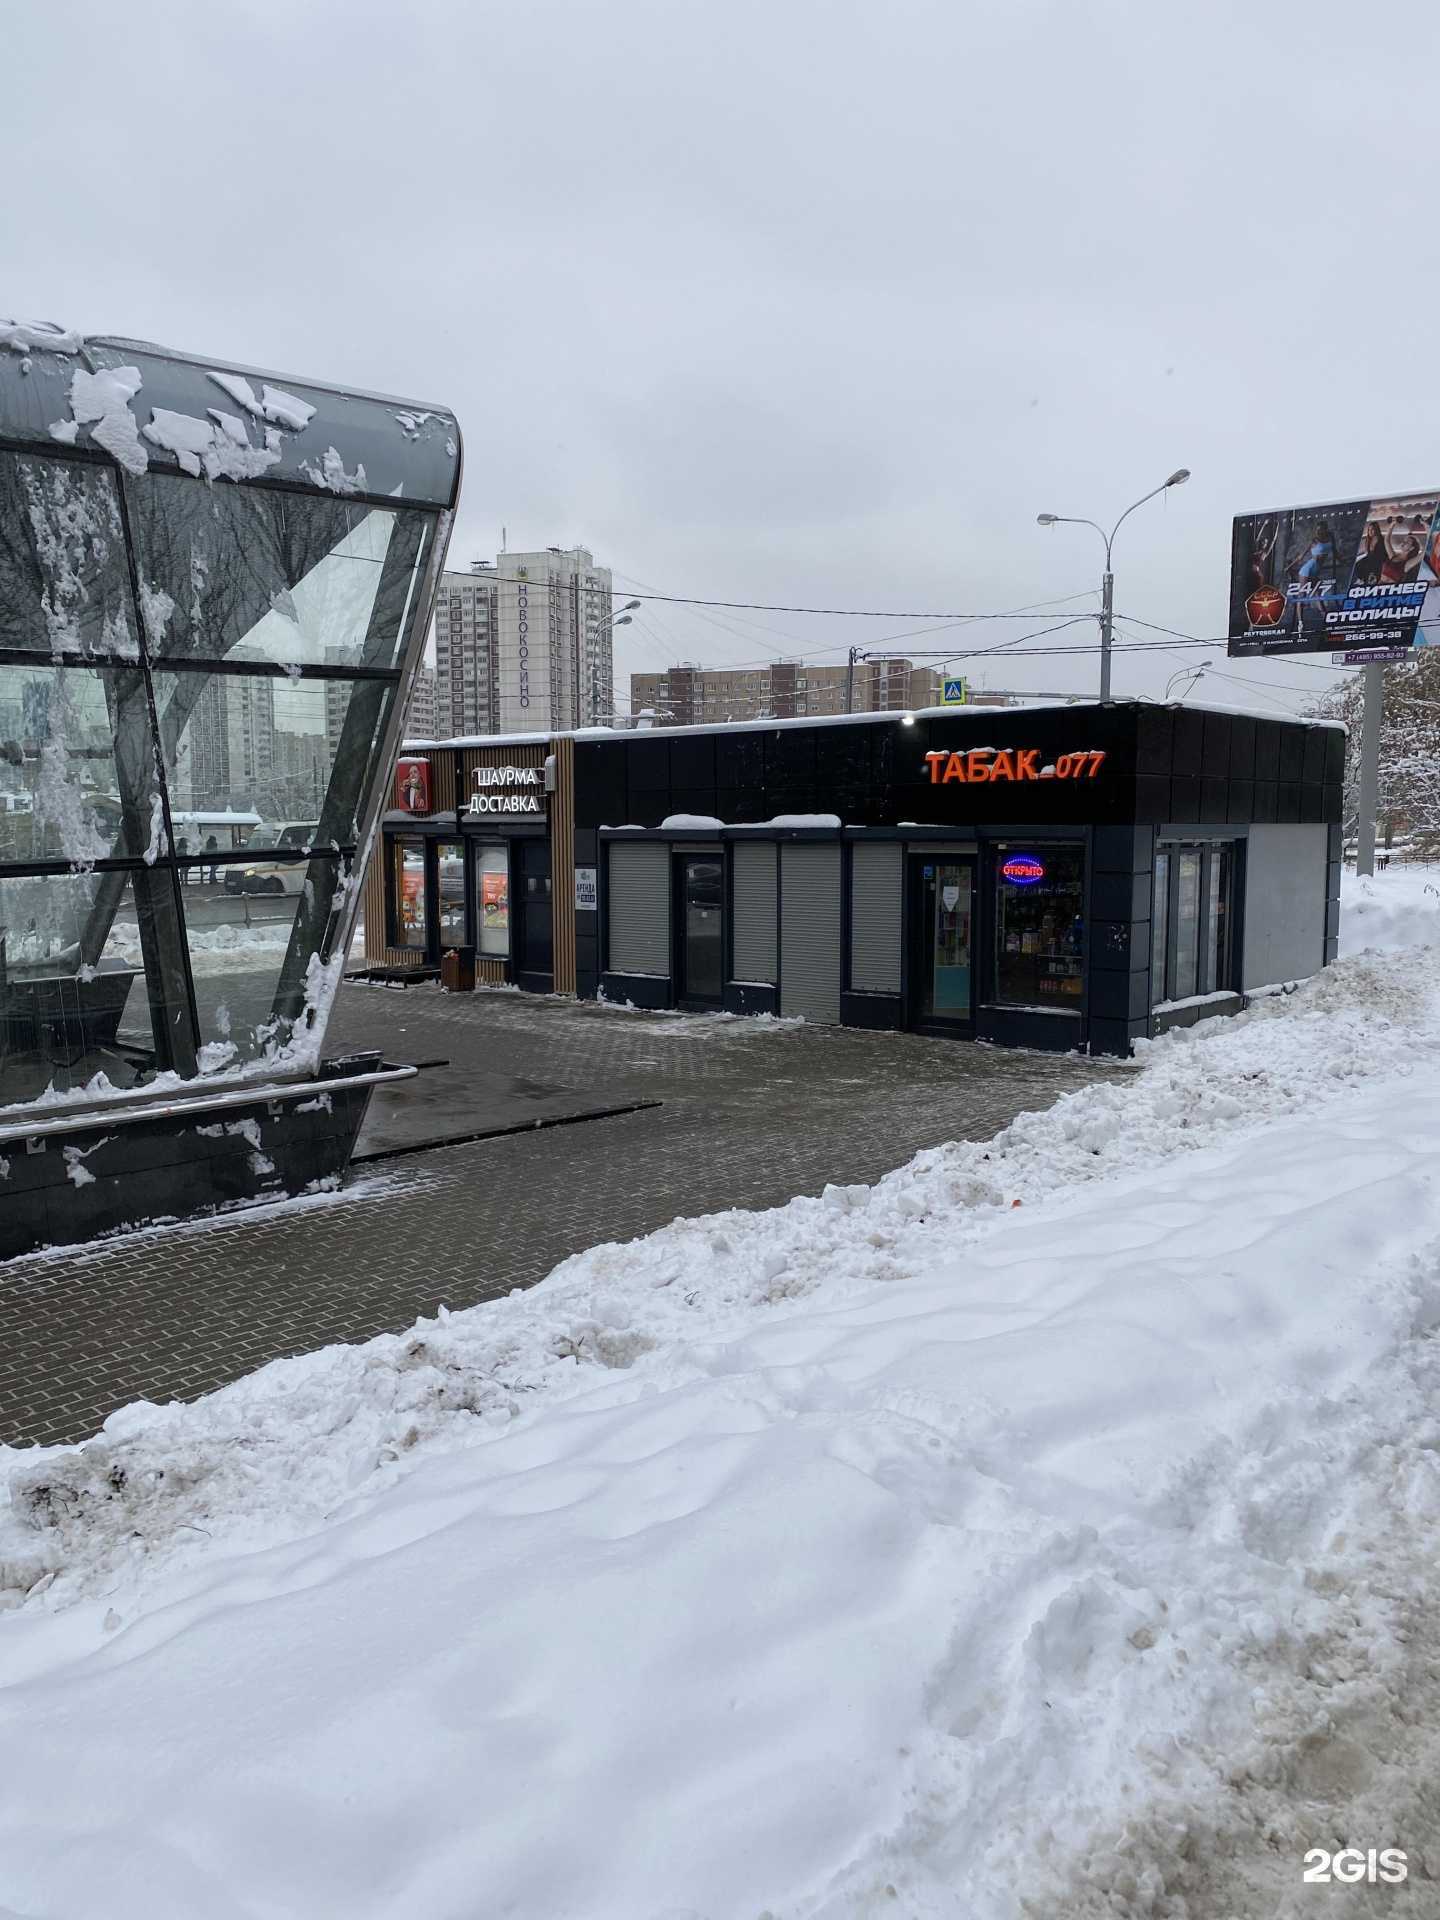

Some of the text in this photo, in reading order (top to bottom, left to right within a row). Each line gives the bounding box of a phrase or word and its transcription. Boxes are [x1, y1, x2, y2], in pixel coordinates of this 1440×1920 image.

[1287, 581, 1332, 597] 24/7
[1348, 581, 1428, 598] ФИТНЕС
[1343, 594, 1422, 609] В РИТМЕ
[1325, 606, 1420, 623] СТОЛИЦЫ
[518, 585, 530, 708] НОВОКОСИНО
[478, 768, 536, 787] ШАУРМА
[470, 795, 537, 814] ДОСТАВКА
[1003, 865, 1043, 877] ОТКРЫТО
